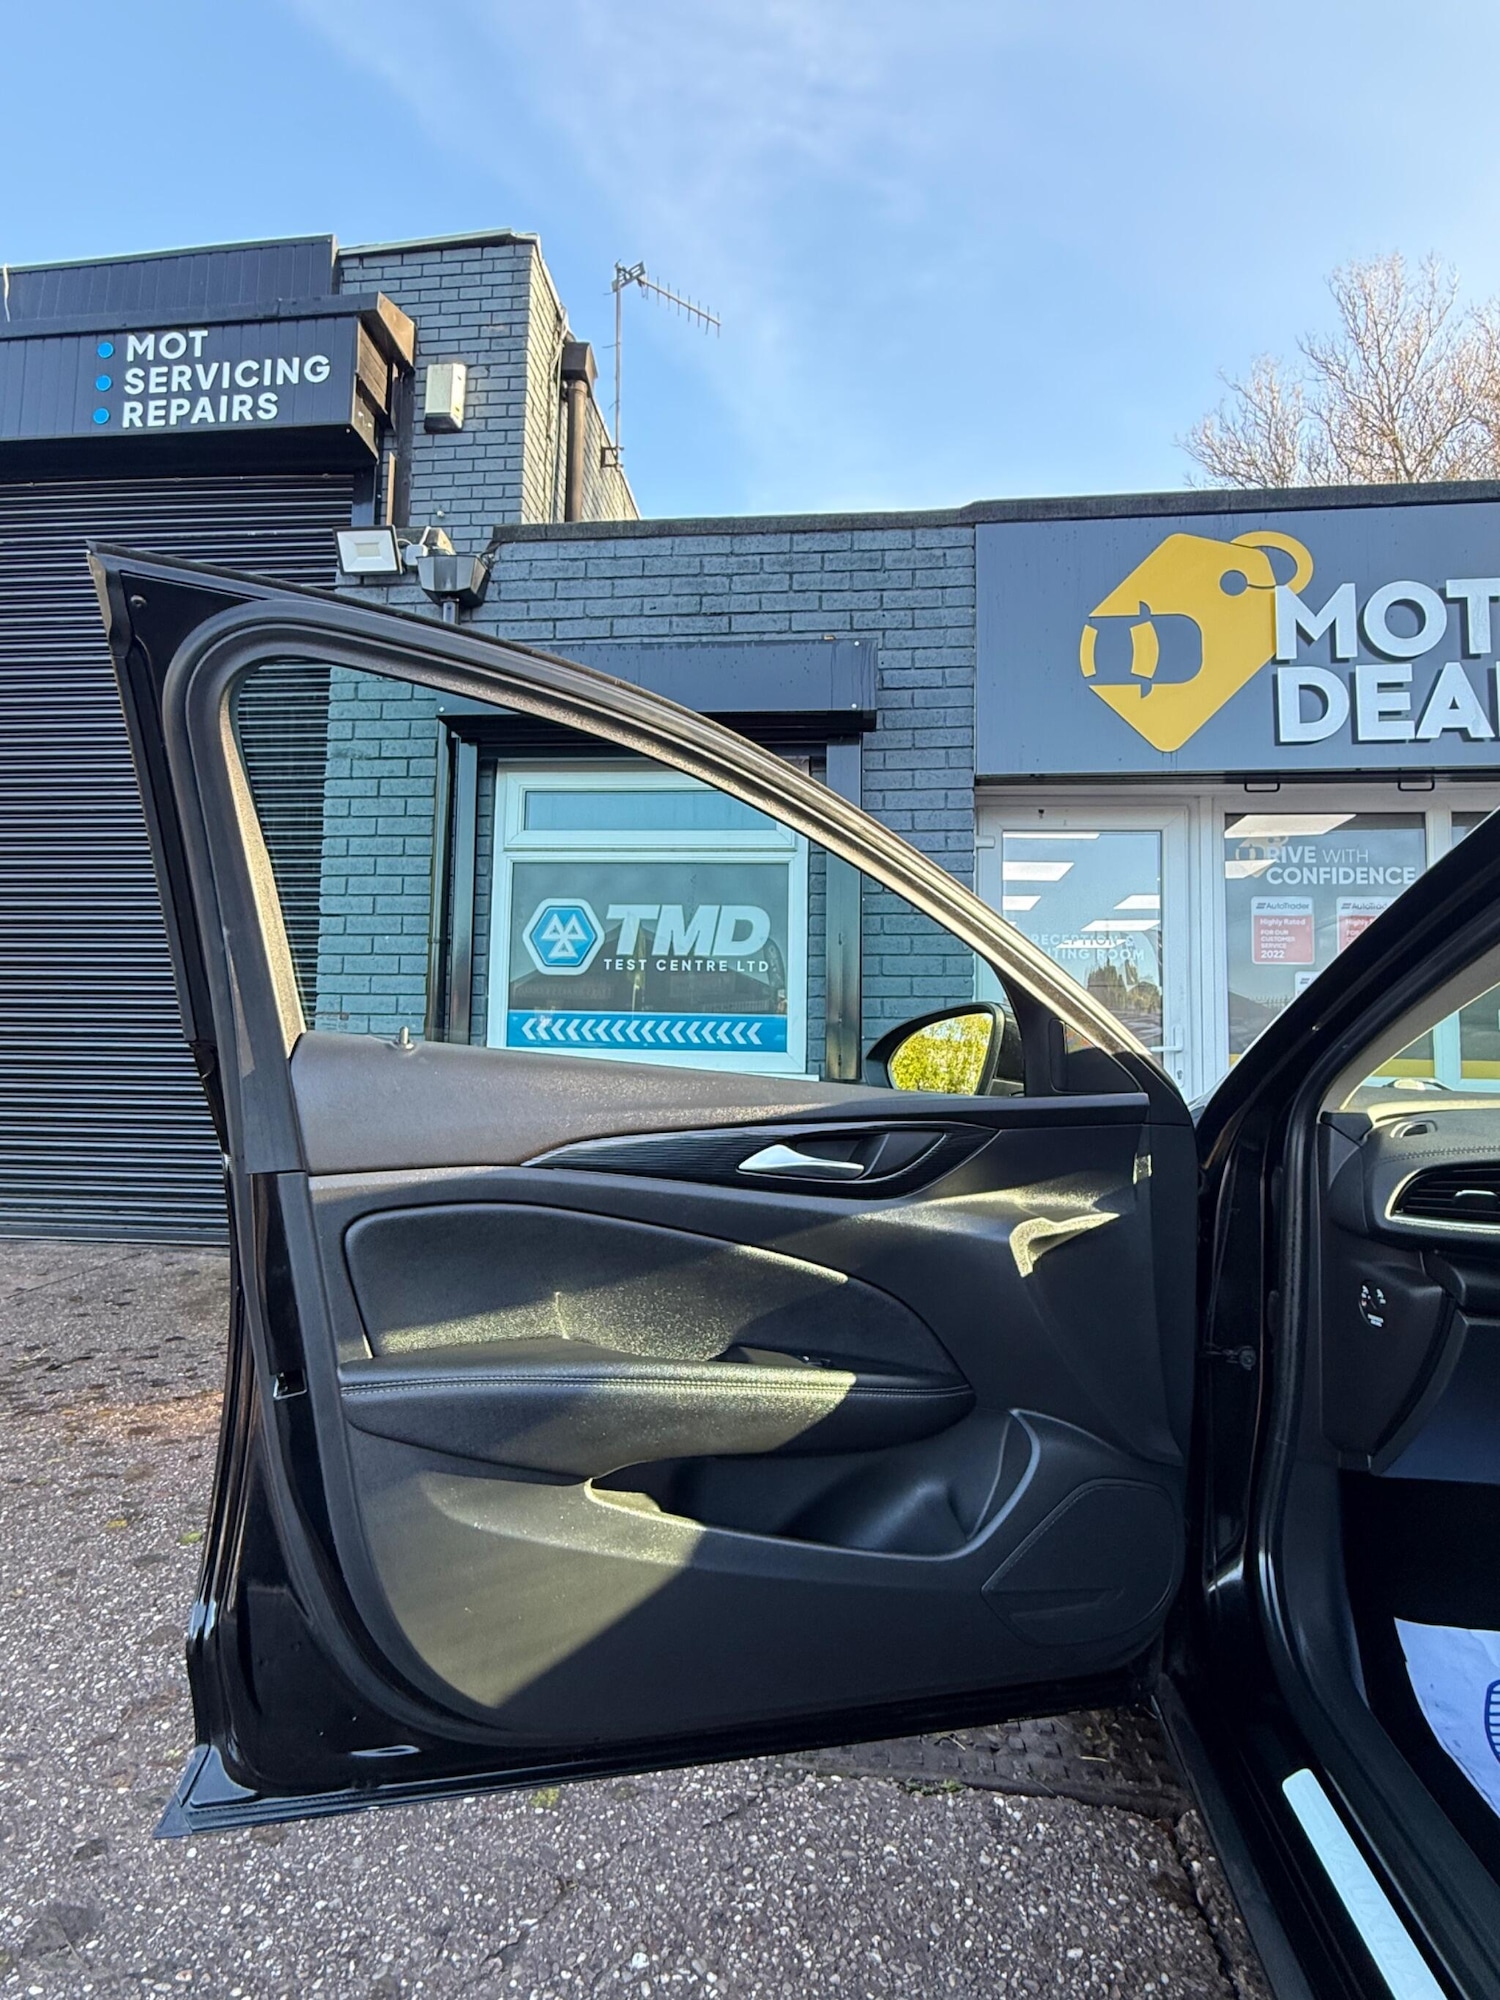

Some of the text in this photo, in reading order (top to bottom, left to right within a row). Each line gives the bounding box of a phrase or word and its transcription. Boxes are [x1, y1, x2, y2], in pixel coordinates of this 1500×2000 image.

[126, 330, 208, 362] MOT
[123, 355, 331, 395] SERVICING
[121, 392, 279, 428] REPAIRS
[1275, 577, 1500, 660] MOT
[1277, 661, 1500, 743] DEA
[1322, 849, 1369, 864] WITH
[1265, 866, 1416, 885] CONFIDENCE
[1266, 902, 1310, 910] AutoTrader
[605, 904, 771, 956] TMD
[1260, 918, 1306, 927] Highly Rated
[1030, 933, 1119, 946] RECEPTION
[1096, 948, 1145, 961] ROOM
[1260, 950, 1286, 959] 2022
[603, 959, 769, 973] TEST CENTRE LTD
